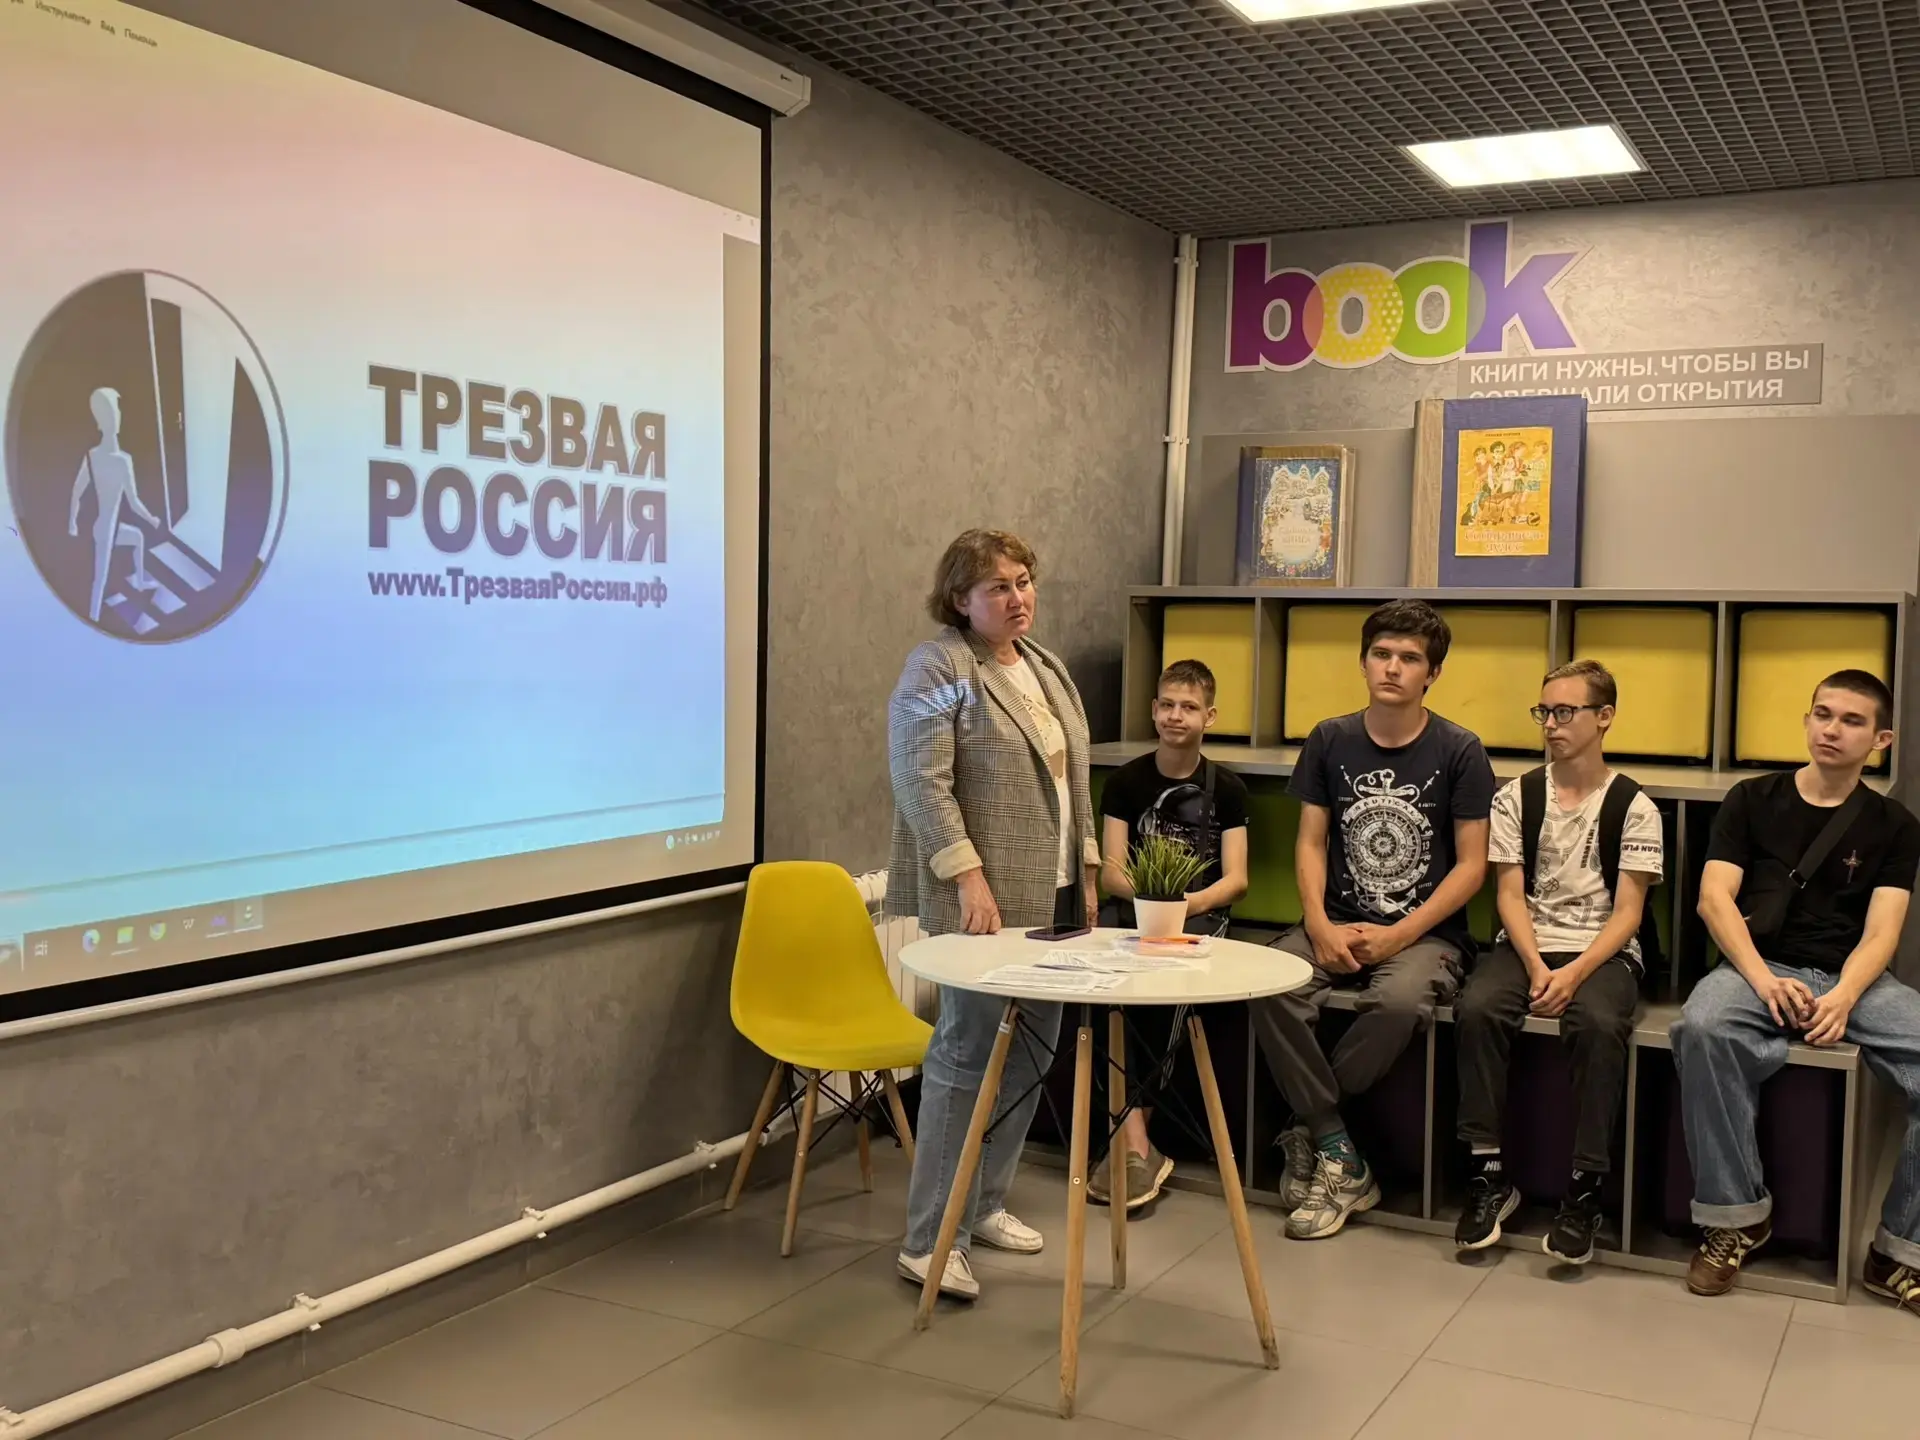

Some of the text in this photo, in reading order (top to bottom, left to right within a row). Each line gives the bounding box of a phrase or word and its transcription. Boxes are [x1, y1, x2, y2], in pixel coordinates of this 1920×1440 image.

[100, 20, 115, 35] Вид
[1226, 218, 1583, 371] book
[1470, 362, 1548, 384] КНИГИ
[1661, 352, 1756, 375] ЧТОБЫ
[1765, 350, 1809, 371] ВЫ
[1637, 378, 1783, 403] ОТКРЫТИЯ
[367, 361, 667, 480] ТРЕЗВАЯ
[367, 457, 667, 564] РОССИЯ
[367, 566, 667, 608] www.ТрезваяРоссия.рф
